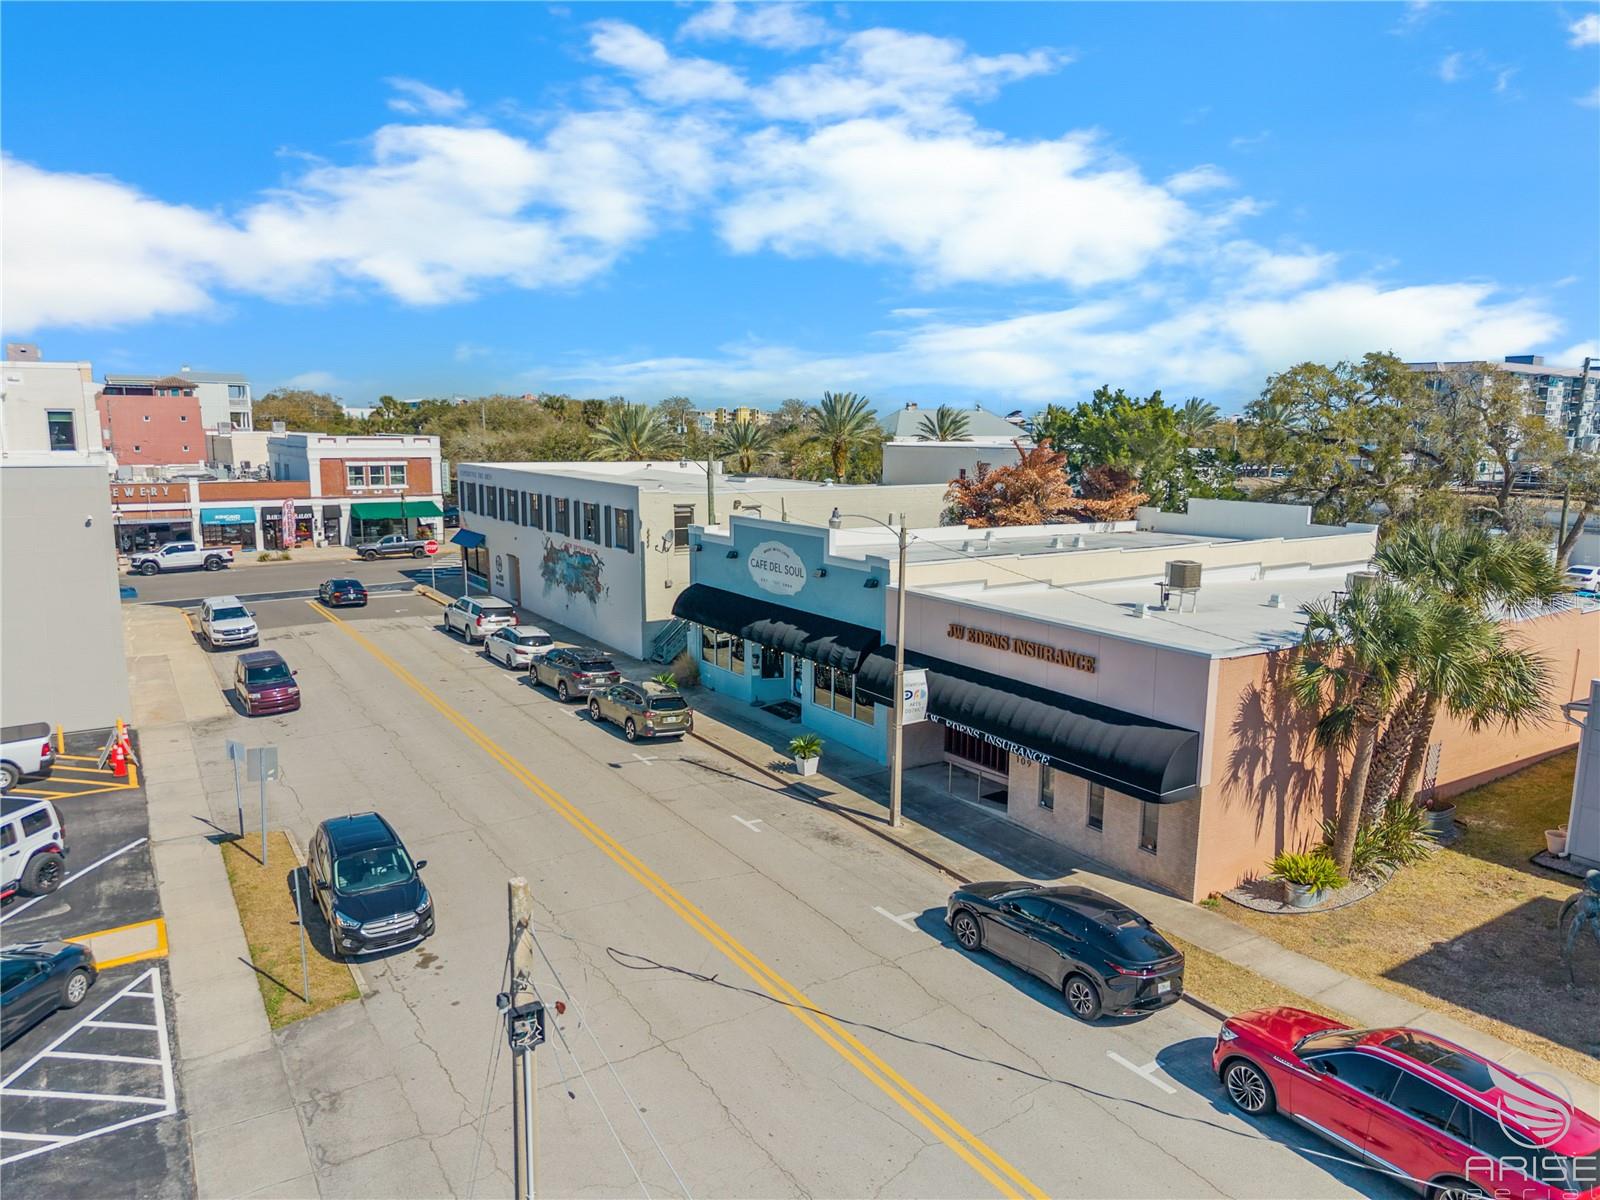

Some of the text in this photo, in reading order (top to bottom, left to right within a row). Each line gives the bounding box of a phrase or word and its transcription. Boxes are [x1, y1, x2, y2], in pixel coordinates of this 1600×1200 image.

[112, 487, 169, 497] EWERY
[751, 558, 804, 578] CAFE DEL SOUL
[947, 623, 1096, 673] JW EDENS INSURANCE
[984, 733, 1050, 766] INSURANCE
[1016, 756, 1032, 767] 109
